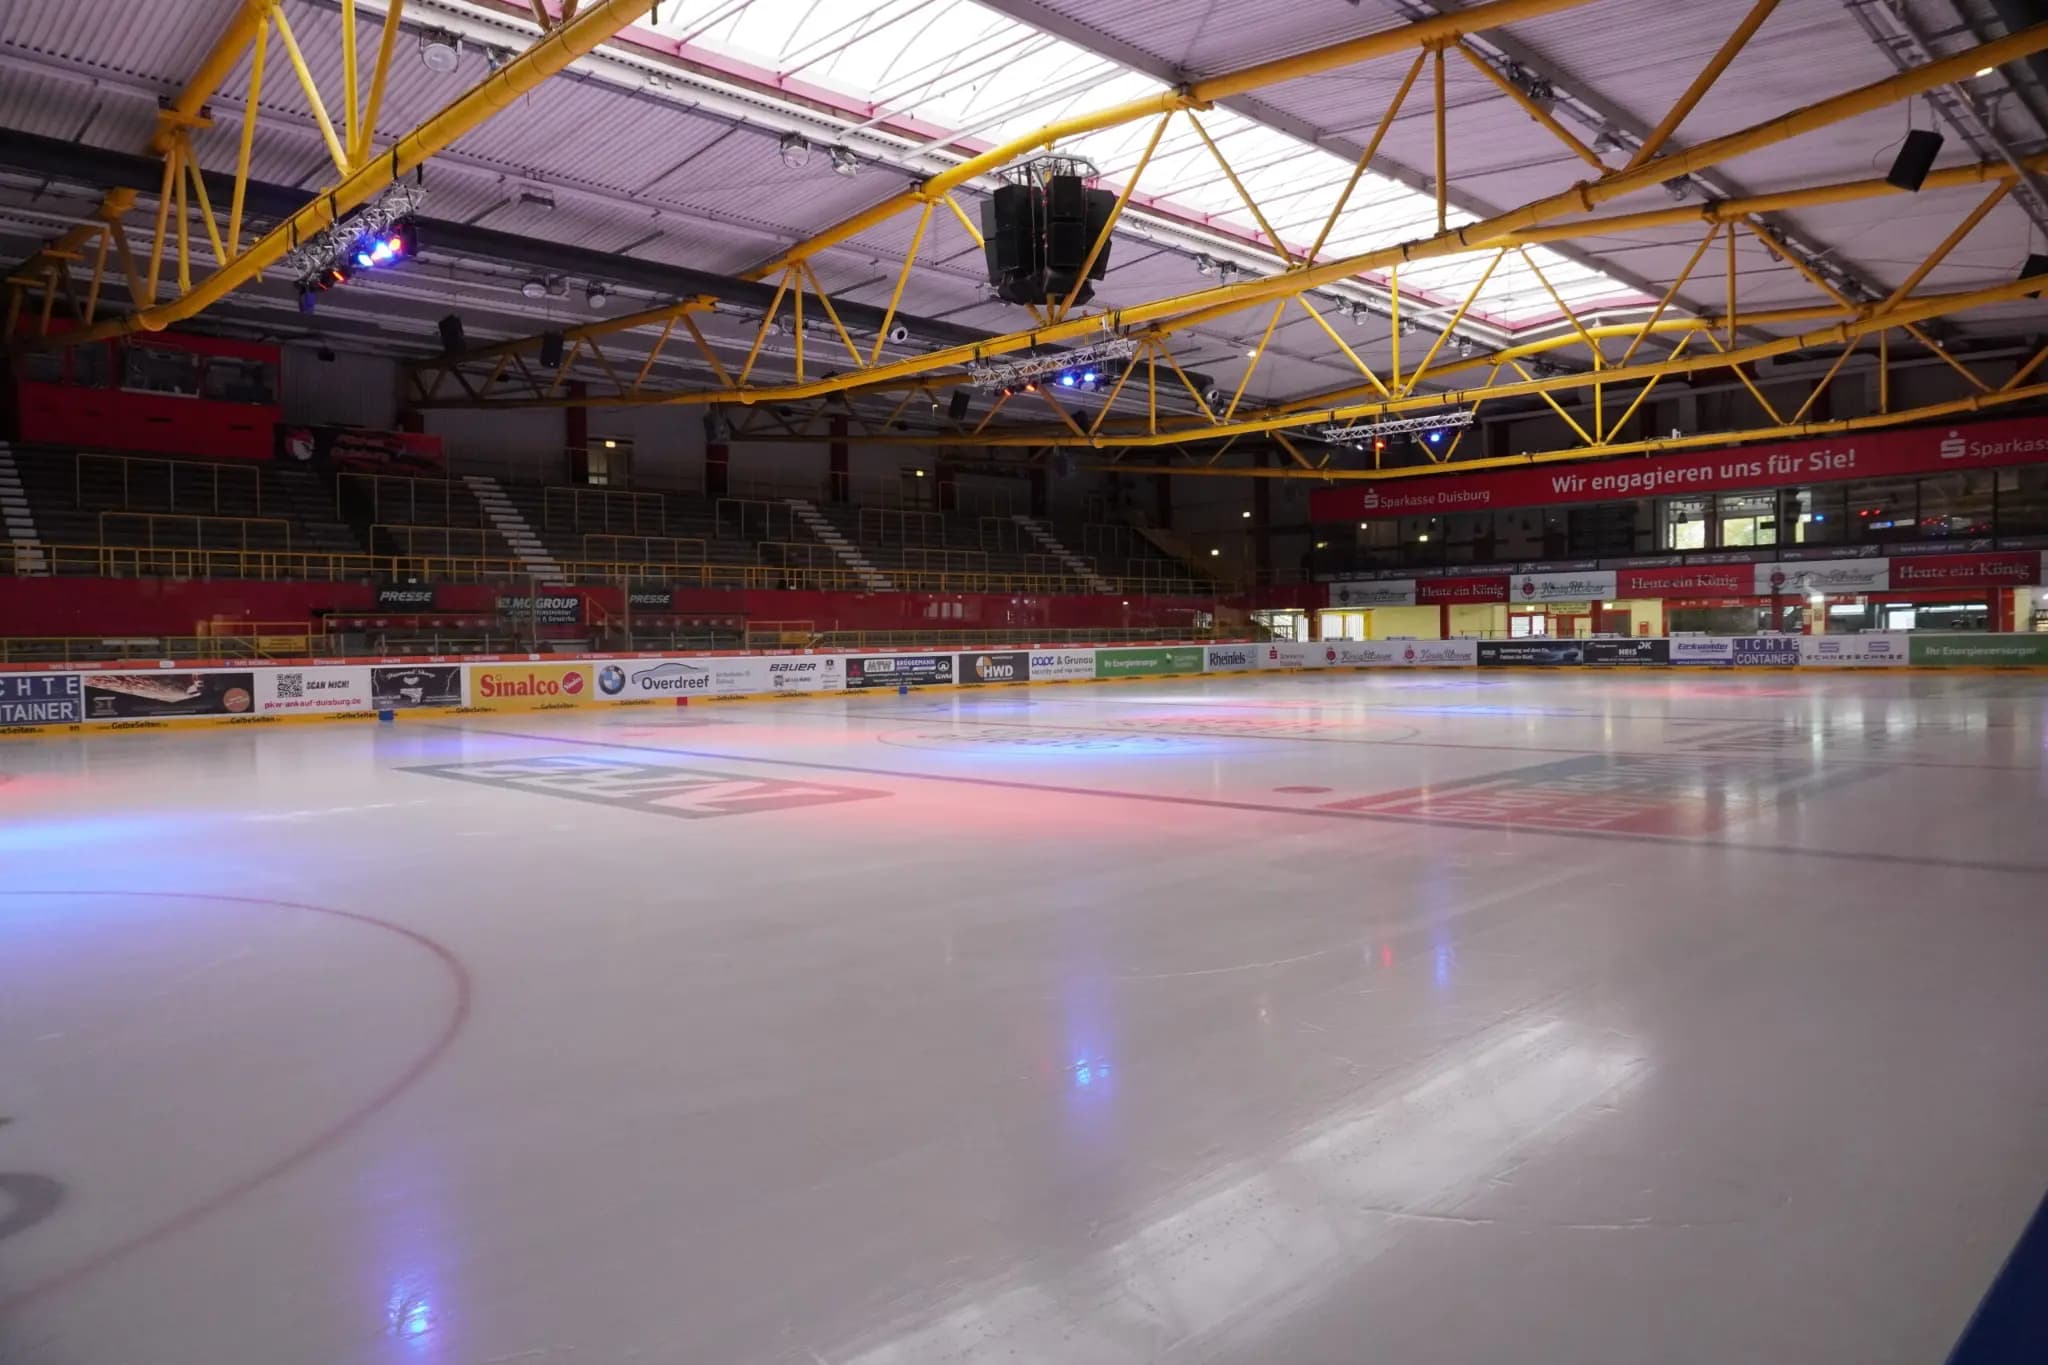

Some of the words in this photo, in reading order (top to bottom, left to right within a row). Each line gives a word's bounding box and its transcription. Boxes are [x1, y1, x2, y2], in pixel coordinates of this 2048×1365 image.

[1969, 438, 2048, 458] Sparkas
[1552, 475, 1586, 494] Wir
[1592, 466, 1714, 492] engagieren
[1720, 461, 1761, 479] uns
[1768, 454, 1803, 475] für
[1808, 449, 1855, 471] Sie!
[1381, 496, 1435, 509] Sparkasse
[1438, 490, 1490, 504] Duisburg
[1900, 565, 1946, 580] Heute
[1950, 564, 1974, 578] ein
[1980, 561, 2029, 580] König
[1631, 577, 1671, 589] Heute
[1673, 576, 1692, 588] ein
[1696, 573, 1738, 590] König
[380, 591, 432, 601] PRESSE
[629, 594, 671, 604] PRESSE
[1422, 587, 1451, 598] Heute
[1453, 586, 1470, 596] ein
[1473, 584, 1503, 597] König
[1734, 639, 1799, 650] LICHTE
[1736, 653, 1795, 665] CONTAINER
[983, 665, 1014, 678] HWD
[306, 681, 326, 690] SCAN
[480, 674, 560, 698] Sinalco
[641, 674, 710, 690] Overdreef
[0, 702, 74, 721] TAINER
